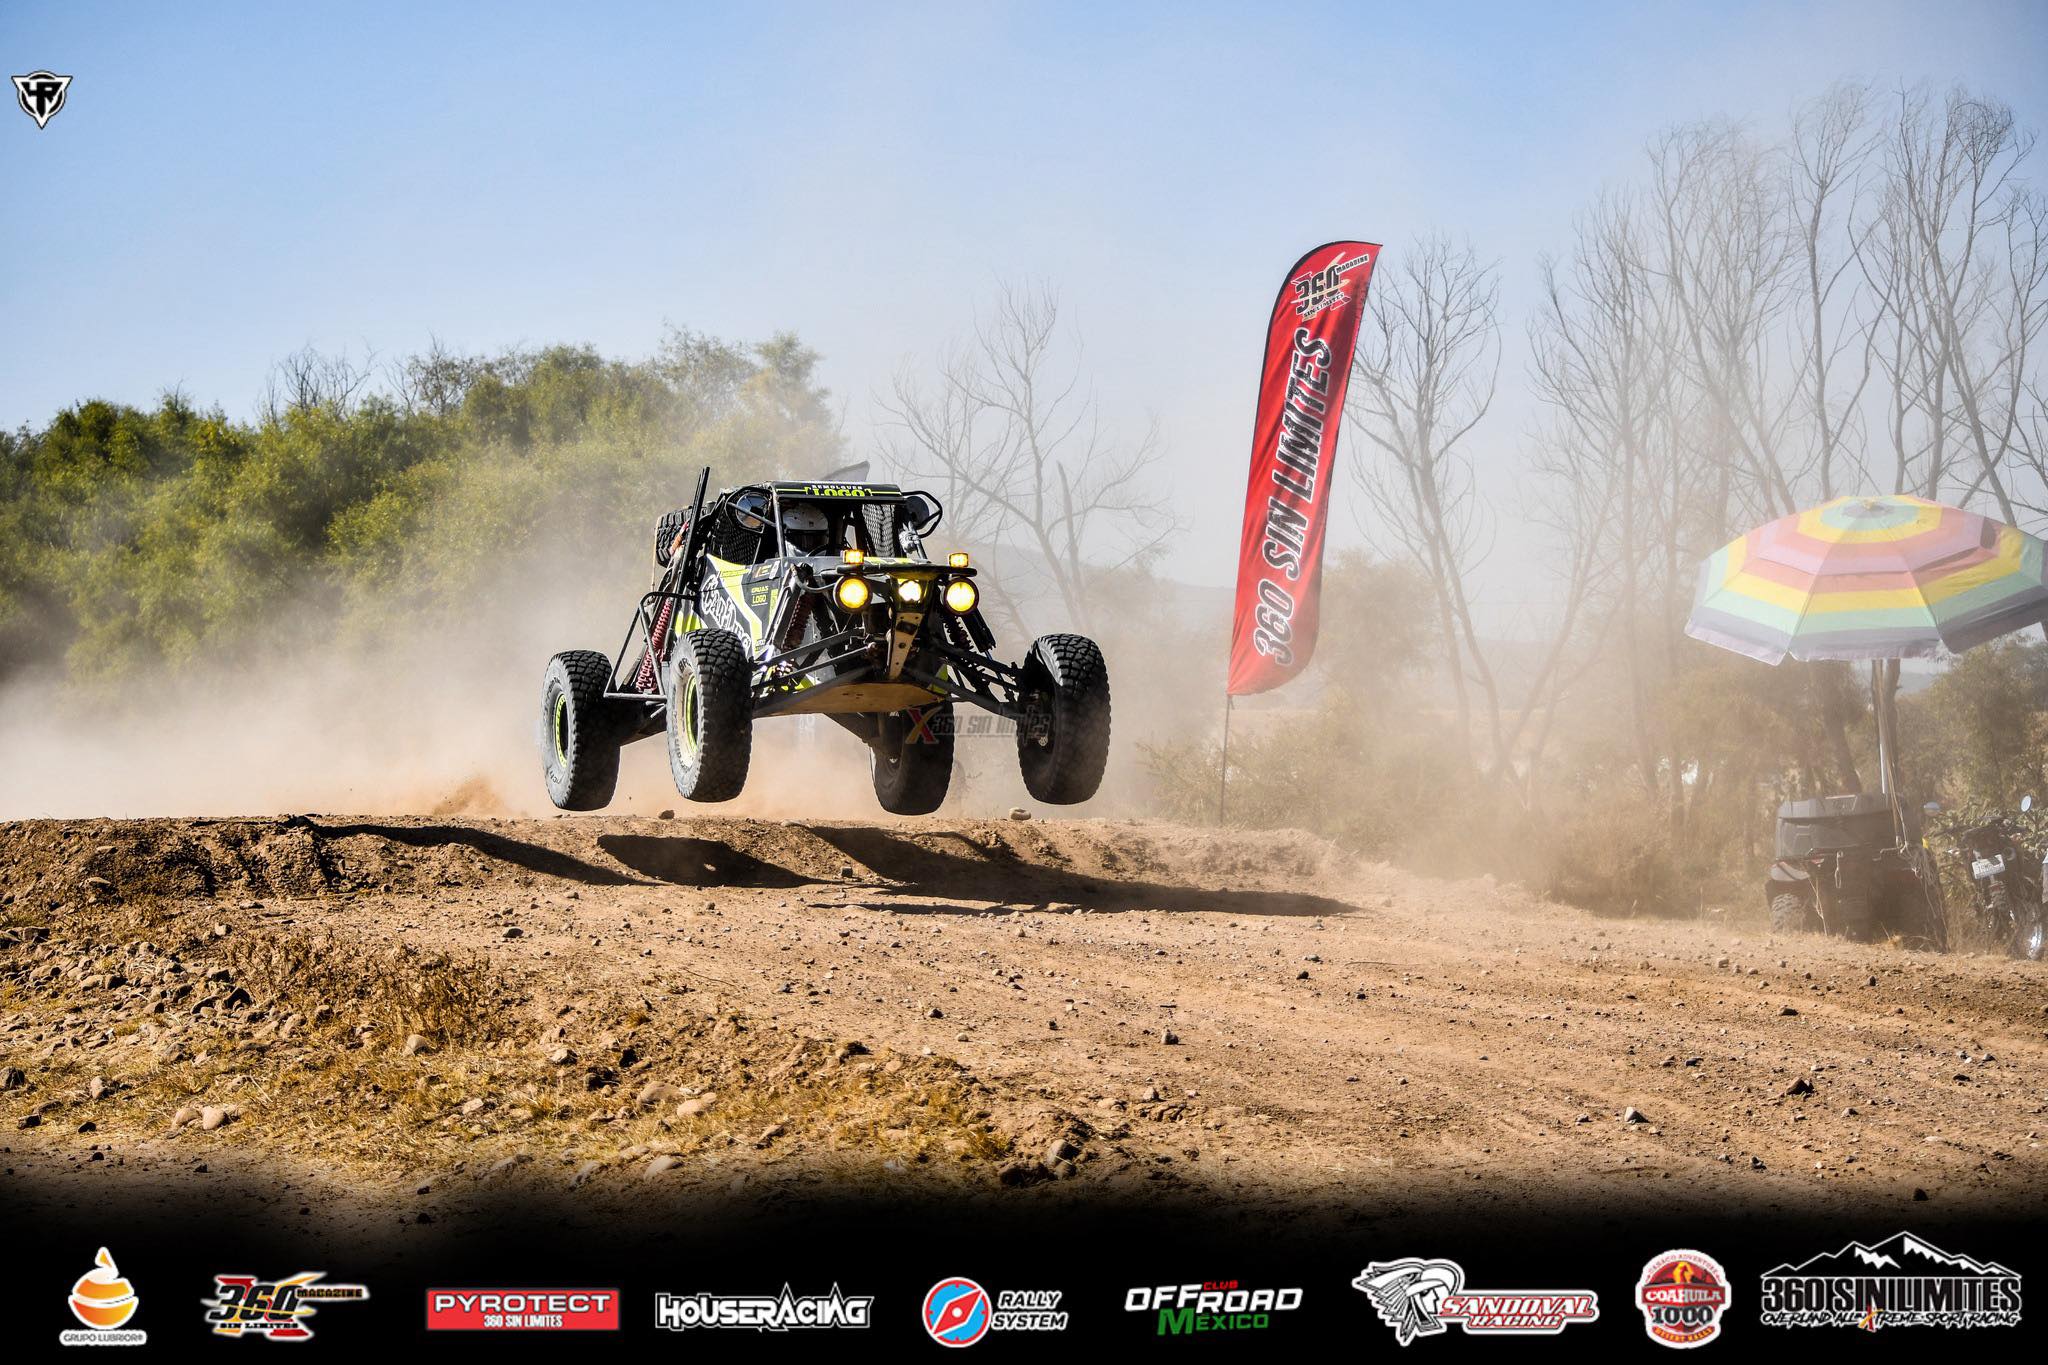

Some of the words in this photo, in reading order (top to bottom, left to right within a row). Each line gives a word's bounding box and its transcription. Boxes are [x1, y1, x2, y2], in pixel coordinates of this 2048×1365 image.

[1295, 264, 1341, 314] 360
[1271, 326, 1332, 504] LIMITES
[1262, 496, 1309, 581] SIN
[1253, 578, 1295, 666] 360
